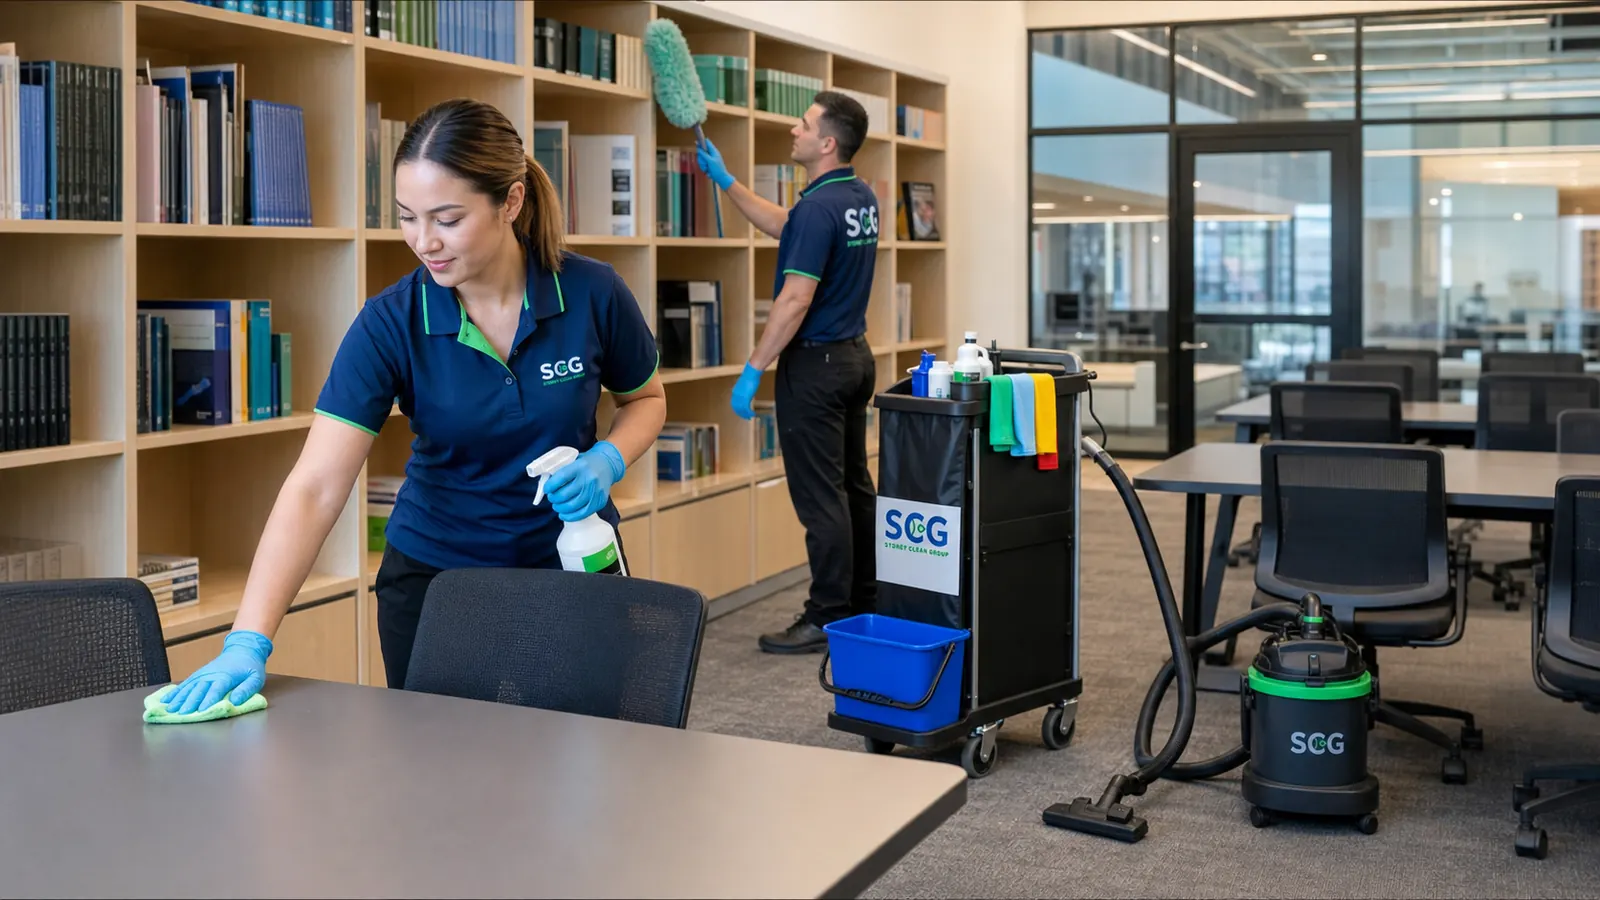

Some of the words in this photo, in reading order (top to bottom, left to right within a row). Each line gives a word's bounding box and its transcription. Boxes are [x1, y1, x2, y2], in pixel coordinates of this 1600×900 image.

[845, 206, 877, 237] SCG
[540, 356, 584, 380] SCG
[885, 510, 948, 547] SCG
[1290, 732, 1344, 755] SCG
